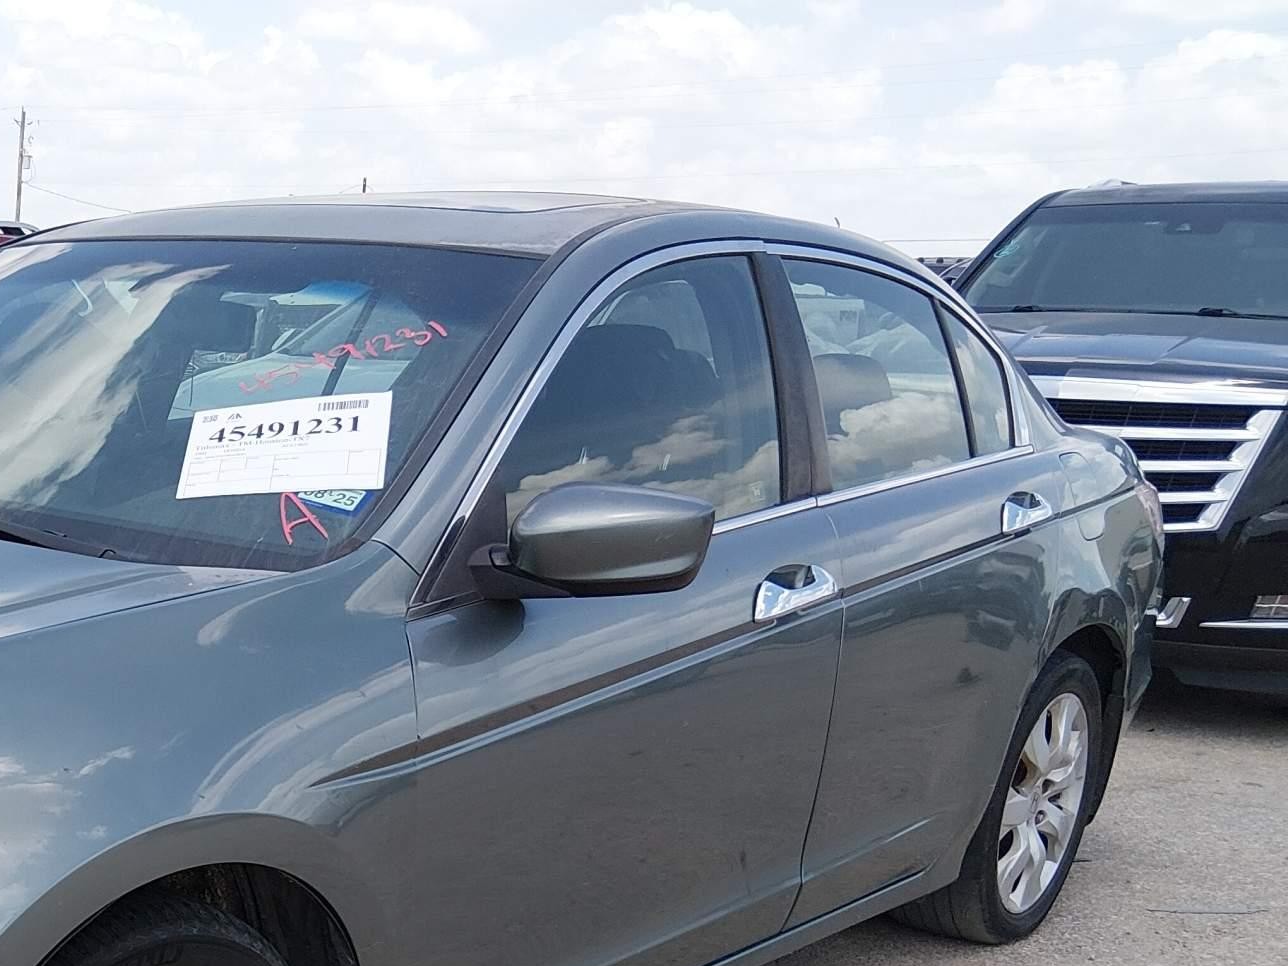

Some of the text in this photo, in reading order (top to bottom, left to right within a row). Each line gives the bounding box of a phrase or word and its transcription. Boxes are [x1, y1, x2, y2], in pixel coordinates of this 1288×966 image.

[209, 416, 360, 443] 45491231
[333, 493, 358, 506] 25
[279, 491, 328, 544] A
